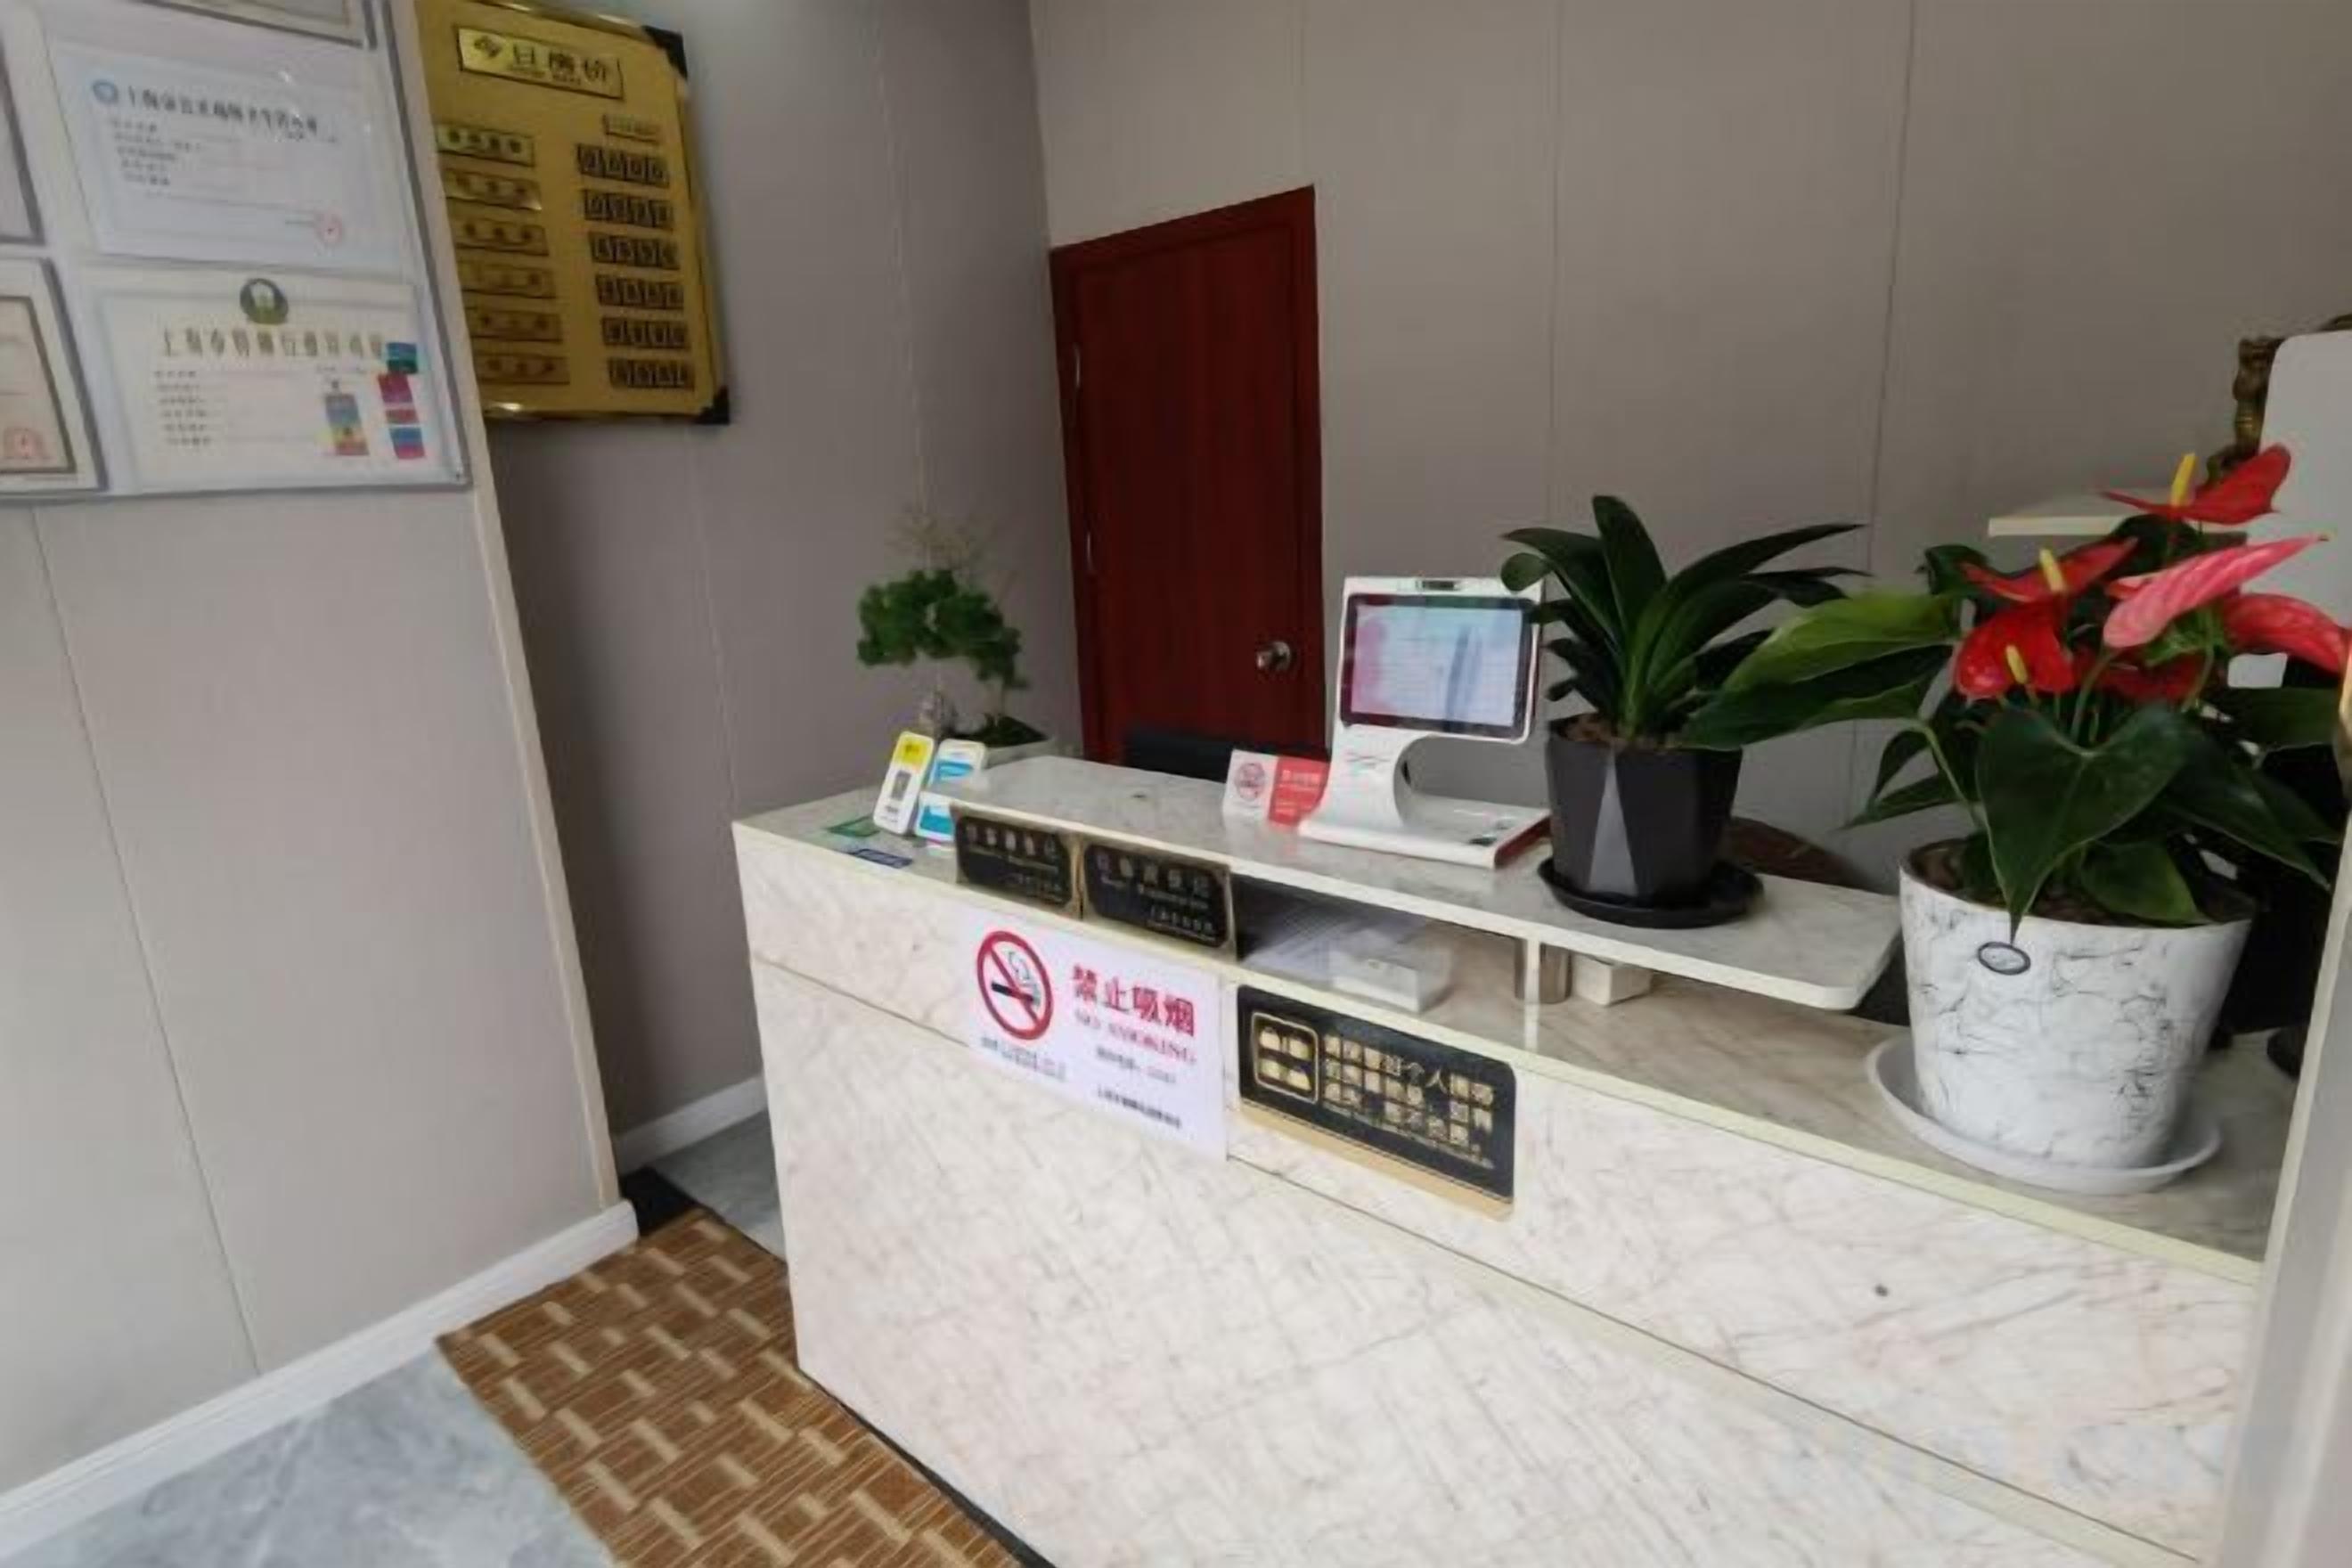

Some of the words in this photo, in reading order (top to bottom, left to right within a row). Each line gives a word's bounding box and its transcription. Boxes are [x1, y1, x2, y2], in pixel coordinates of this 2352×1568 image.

[1073, 963, 1196, 1037] 禁止吸烟
[1074, 1007, 1102, 1030] NO
[1108, 1023, 1196, 1066] SMOKING
